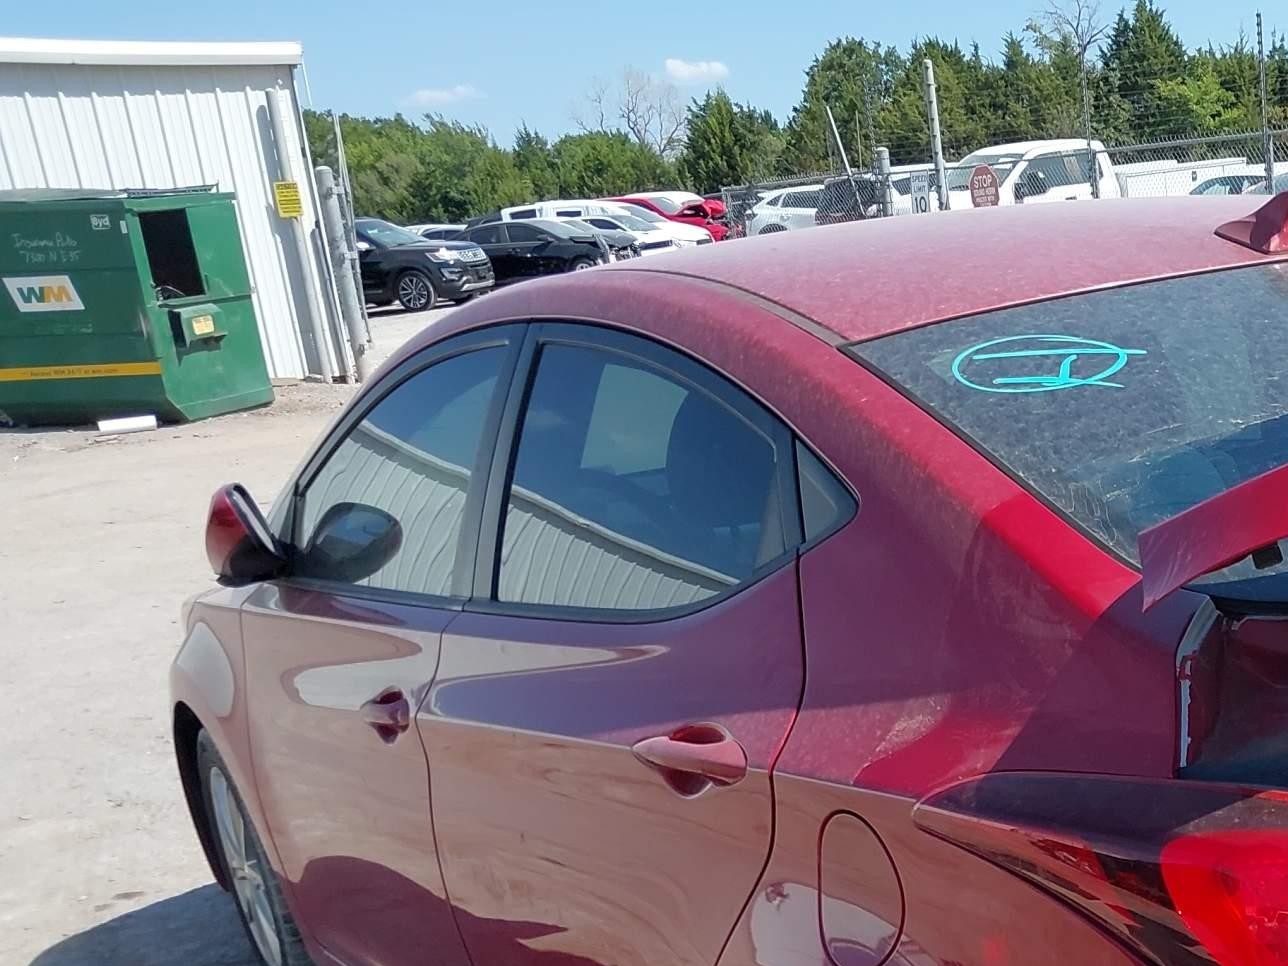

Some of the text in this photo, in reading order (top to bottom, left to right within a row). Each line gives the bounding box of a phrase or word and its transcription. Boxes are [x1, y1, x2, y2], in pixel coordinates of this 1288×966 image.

[911, 174, 928, 183] SPEED
[974, 175, 992, 188] STOP
[914, 196, 928, 214] 10
[16, 285, 73, 304] WM
